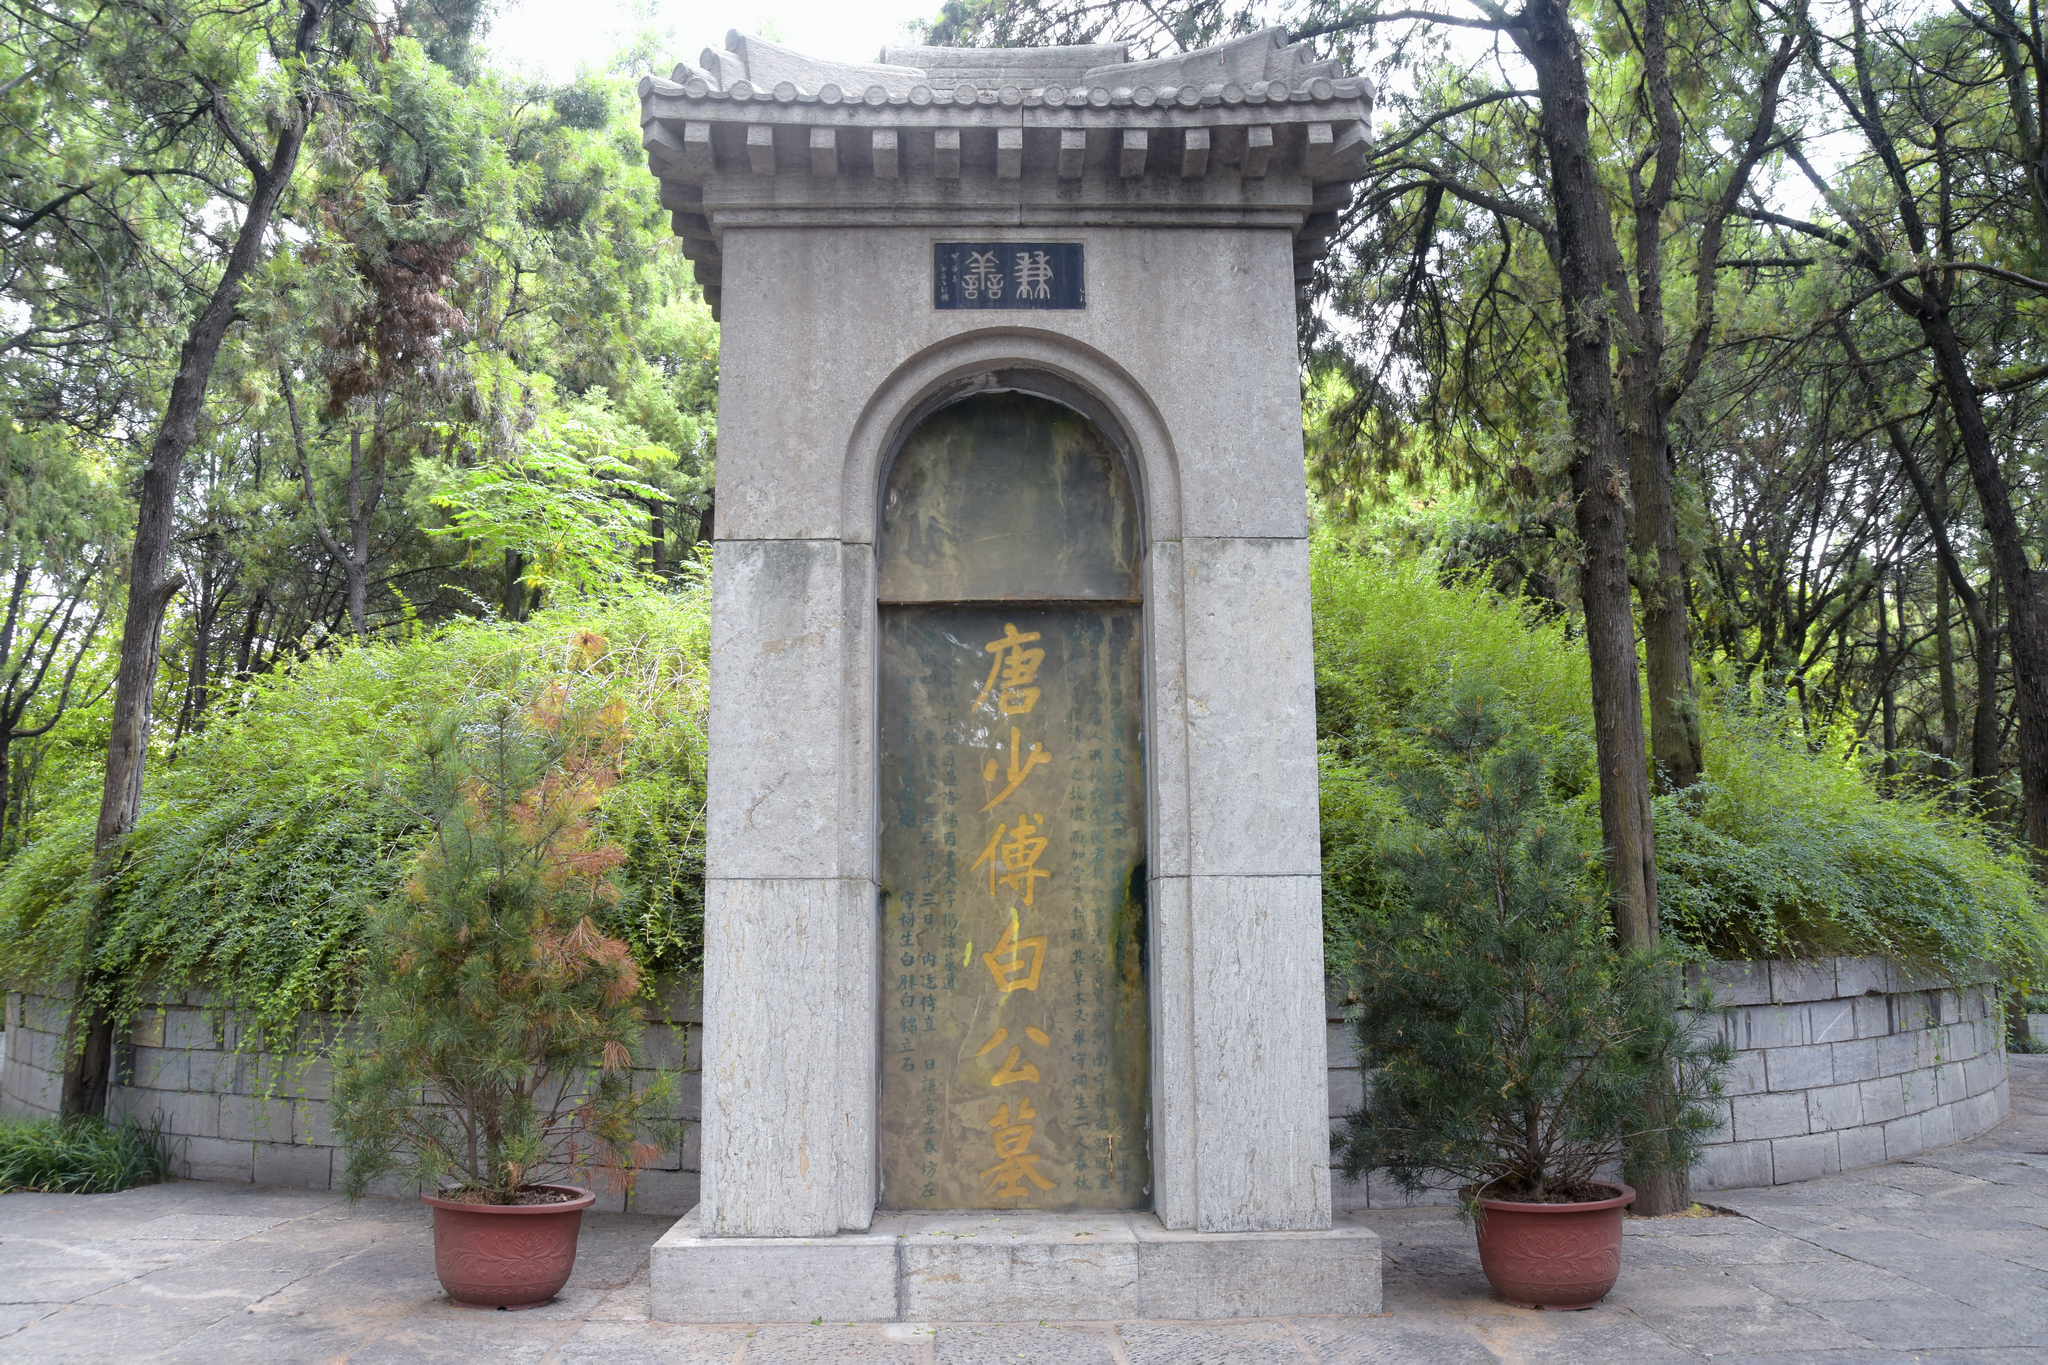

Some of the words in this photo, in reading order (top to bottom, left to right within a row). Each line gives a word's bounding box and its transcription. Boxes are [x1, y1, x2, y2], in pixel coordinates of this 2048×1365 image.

[969, 622, 1057, 1199] 唐少傅白公墓
